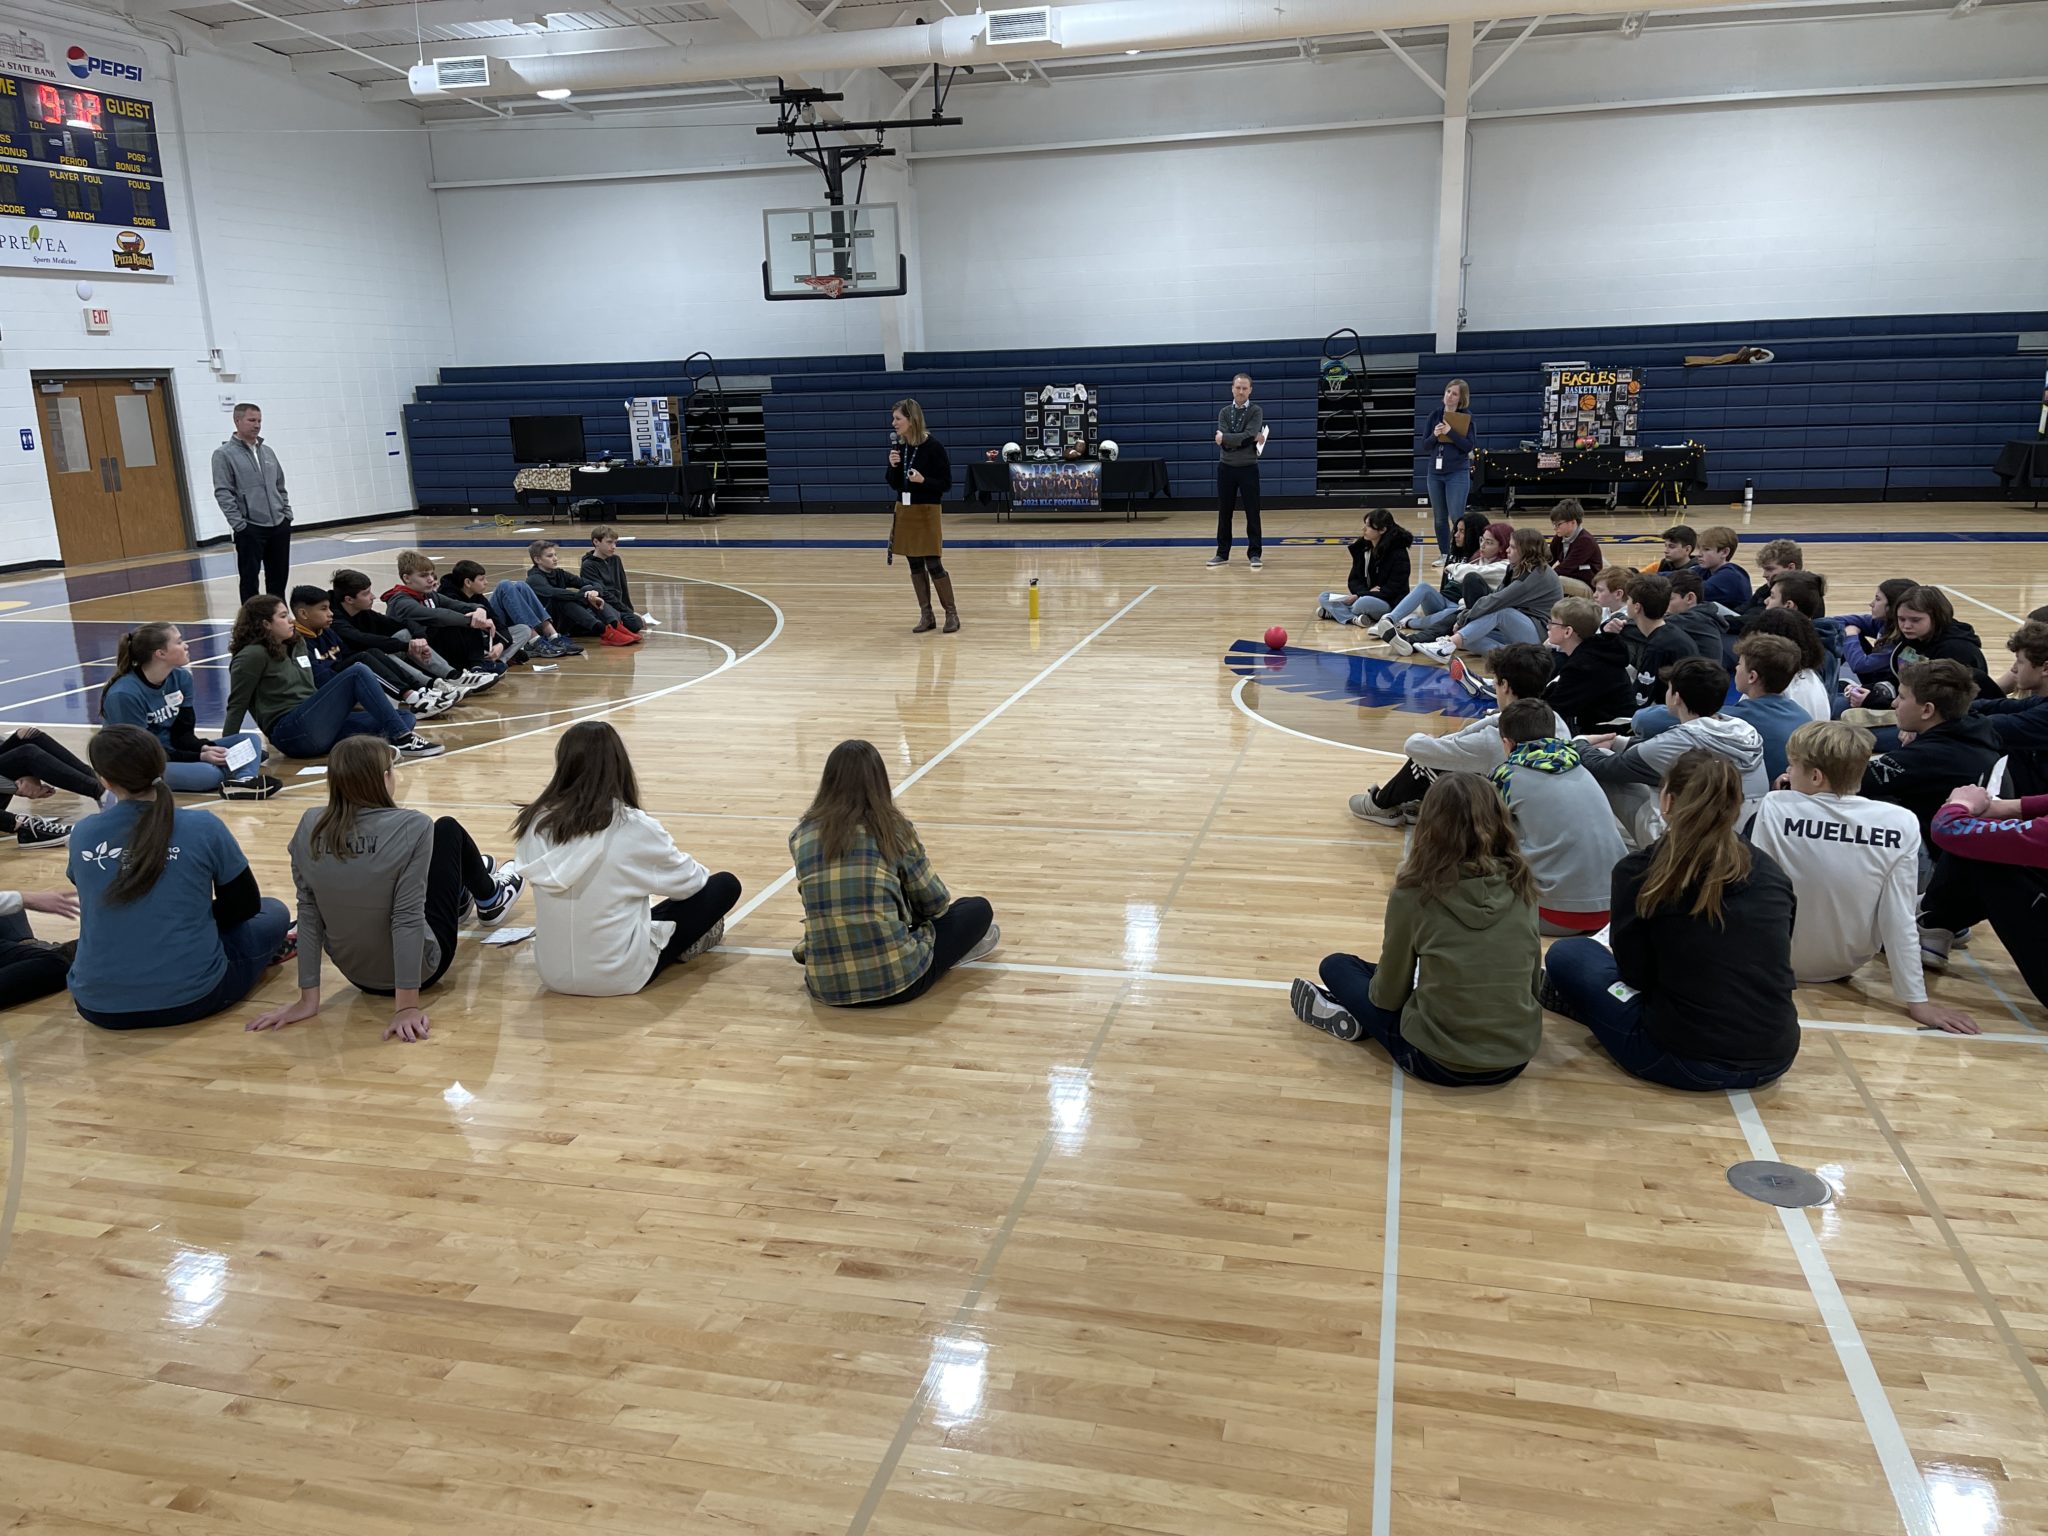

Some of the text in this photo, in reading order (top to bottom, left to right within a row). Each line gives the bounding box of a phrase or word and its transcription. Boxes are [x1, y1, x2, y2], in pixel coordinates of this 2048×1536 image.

[7, 61, 32, 74] STATE
[34, 67, 56, 78] BANK
[88, 56, 142, 82] PEPSI
[105, 98, 150, 120] GUEST
[60, 155, 88, 167] PERIOD
[127, 152, 146, 162] POSS
[115, 161, 141, 173] BONUS
[49, 170, 103, 185] PLAYER FOUL
[128, 180, 151, 190] FOULS
[0, 204, 26, 215] SCORE
[67, 211, 95, 221] MATCH
[133, 217, 156, 227] SCORE
[0, 234, 68, 253] PREVEA
[33, 255, 77, 265] Sports Medicine
[114, 252, 153, 268] Pizza Ranch
[92, 309, 109, 325] EXIT
[1561, 371, 1616, 386] EAGLES
[1565, 385, 1612, 394] BASKETBALL
[1783, 817, 1901, 849] MUELLER
